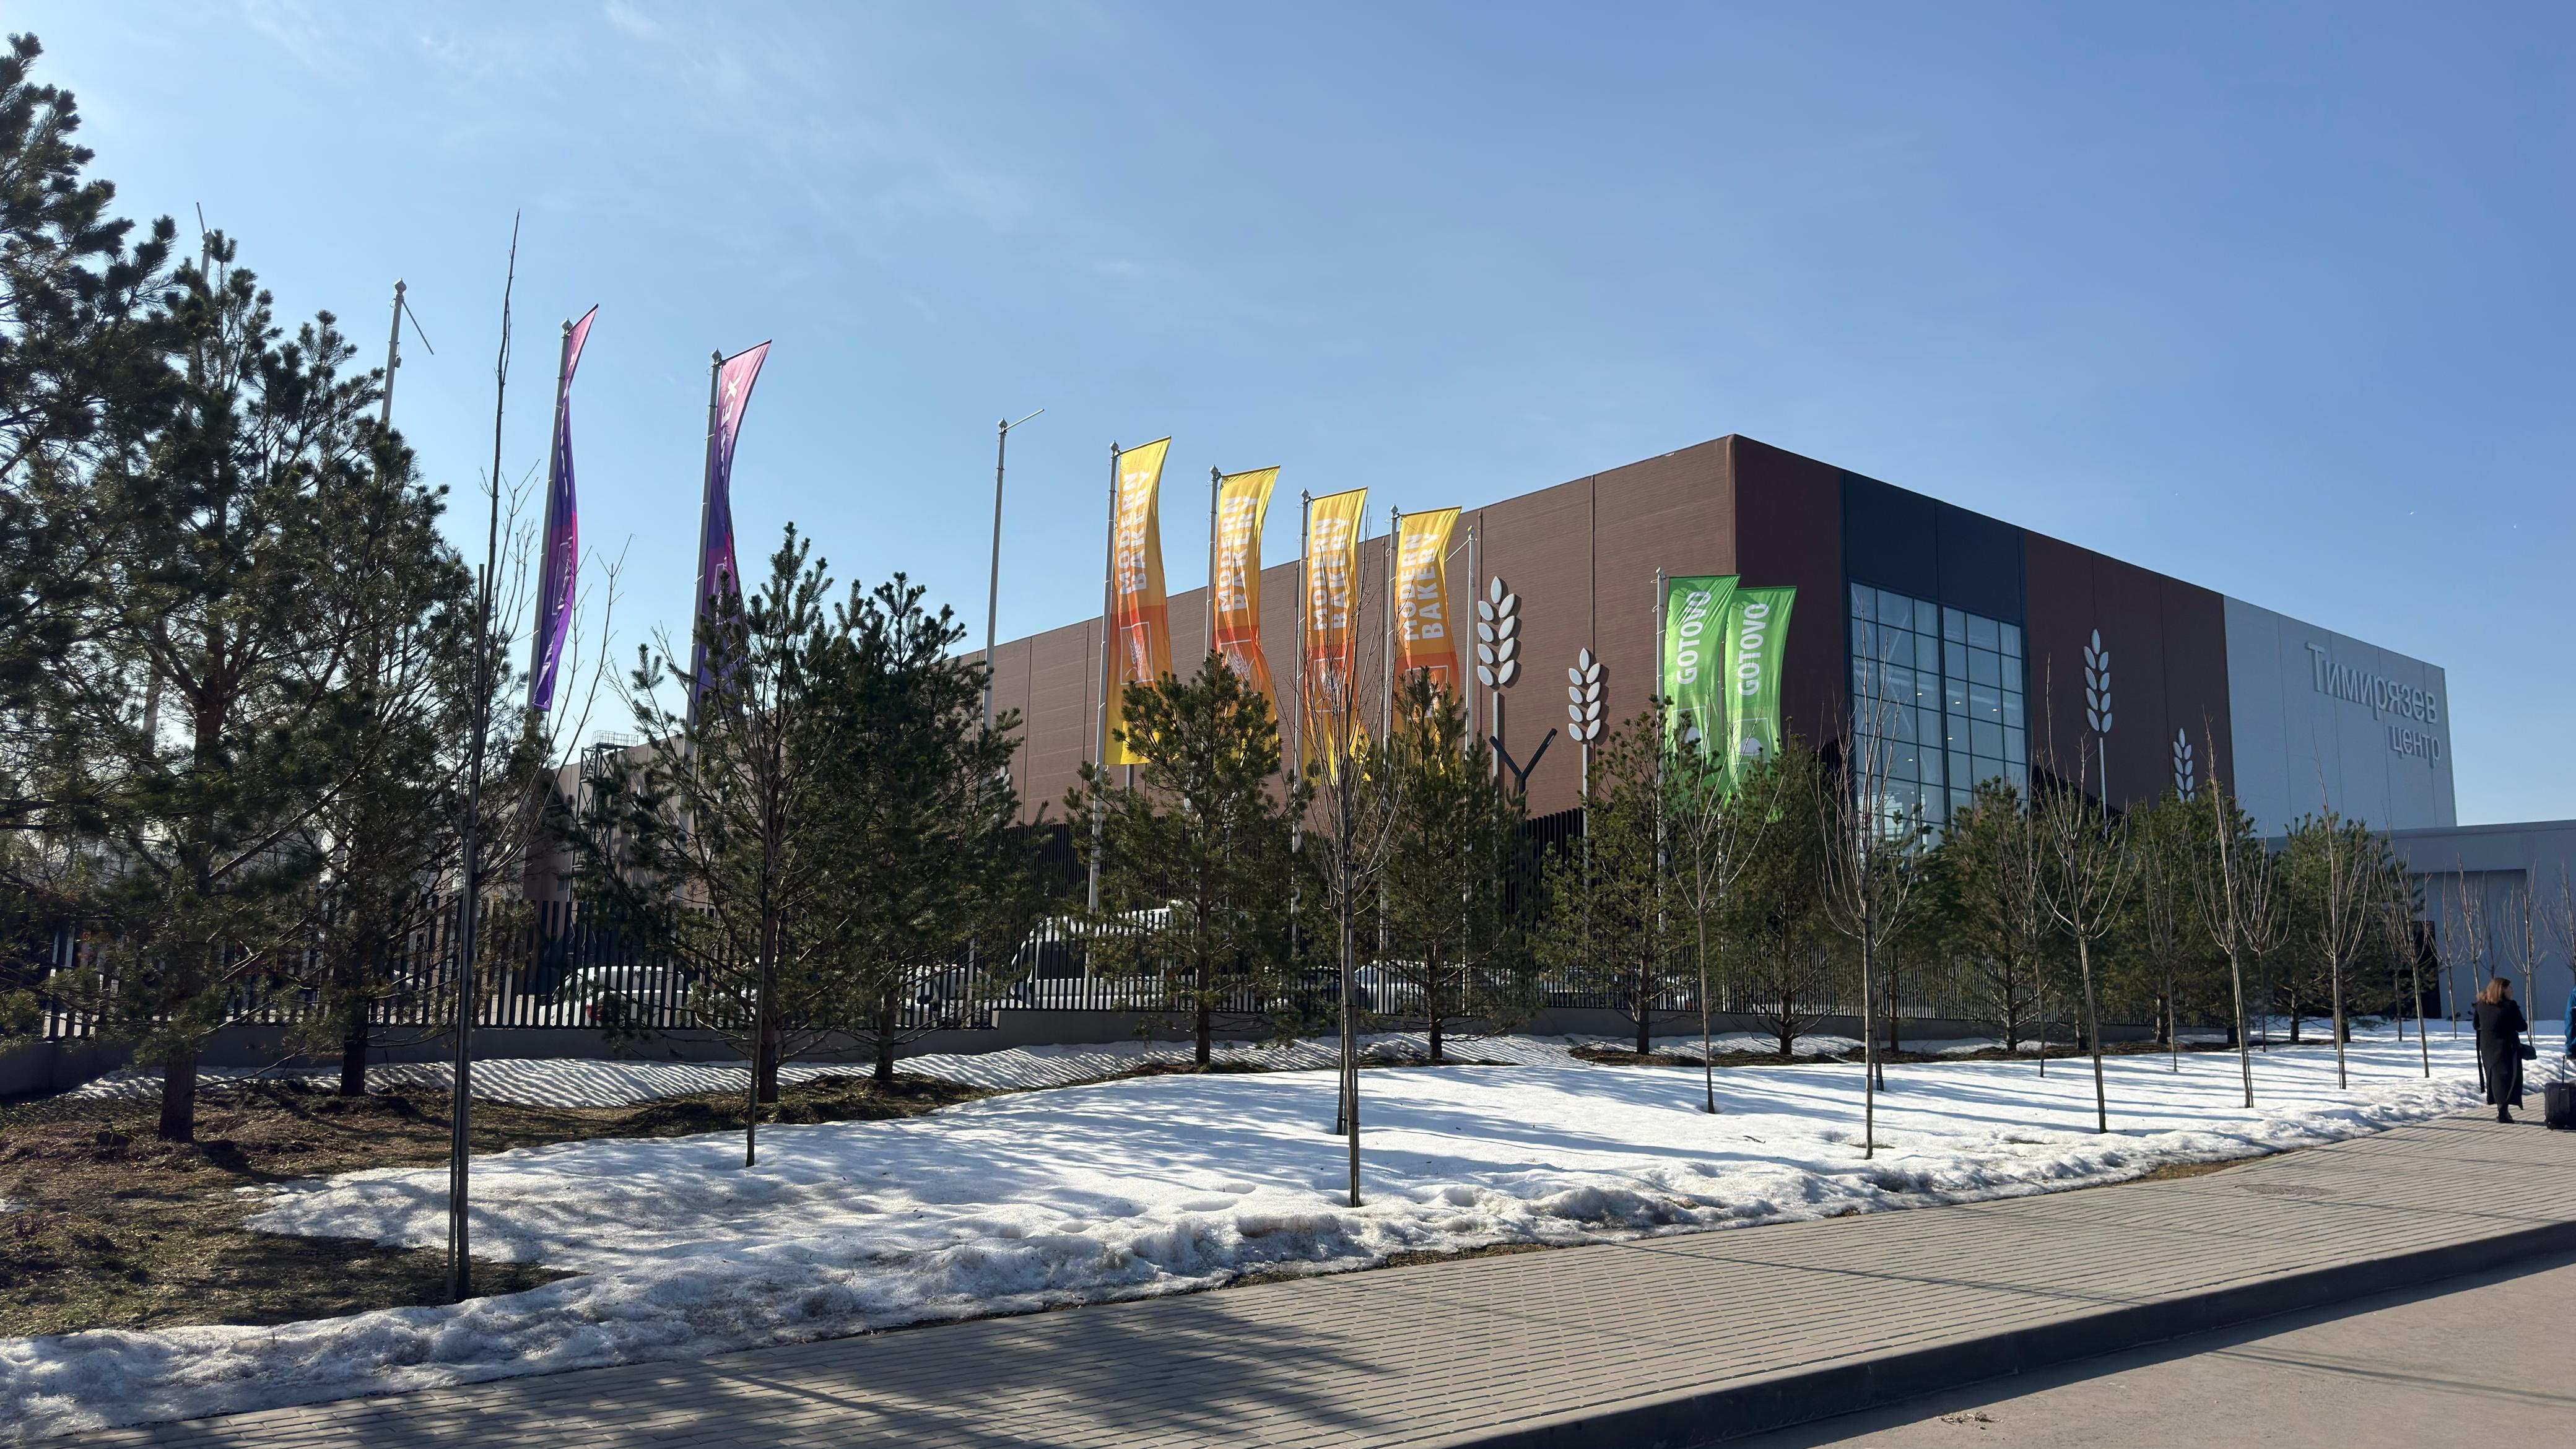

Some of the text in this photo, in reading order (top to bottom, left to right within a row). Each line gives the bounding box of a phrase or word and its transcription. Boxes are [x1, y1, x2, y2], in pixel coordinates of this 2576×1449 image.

[1118, 472, 1138, 594] MODERN
[1130, 470, 1150, 591] BAKERY
[1218, 496, 1241, 612] MODERN
[1232, 495, 1258, 610] BAKERY
[1312, 518, 1332, 631] MODERN
[1329, 517, 1349, 629] BAKERY
[1417, 532, 1444, 639] BAKERY
[1399, 533, 1422, 641] MODERN
[1676, 591, 1712, 684] GOTOVO
[1737, 603, 1769, 696] GOTOVO
[2305, 642, 2437, 724] Тимирязев
[2388, 725, 2440, 768] центр
